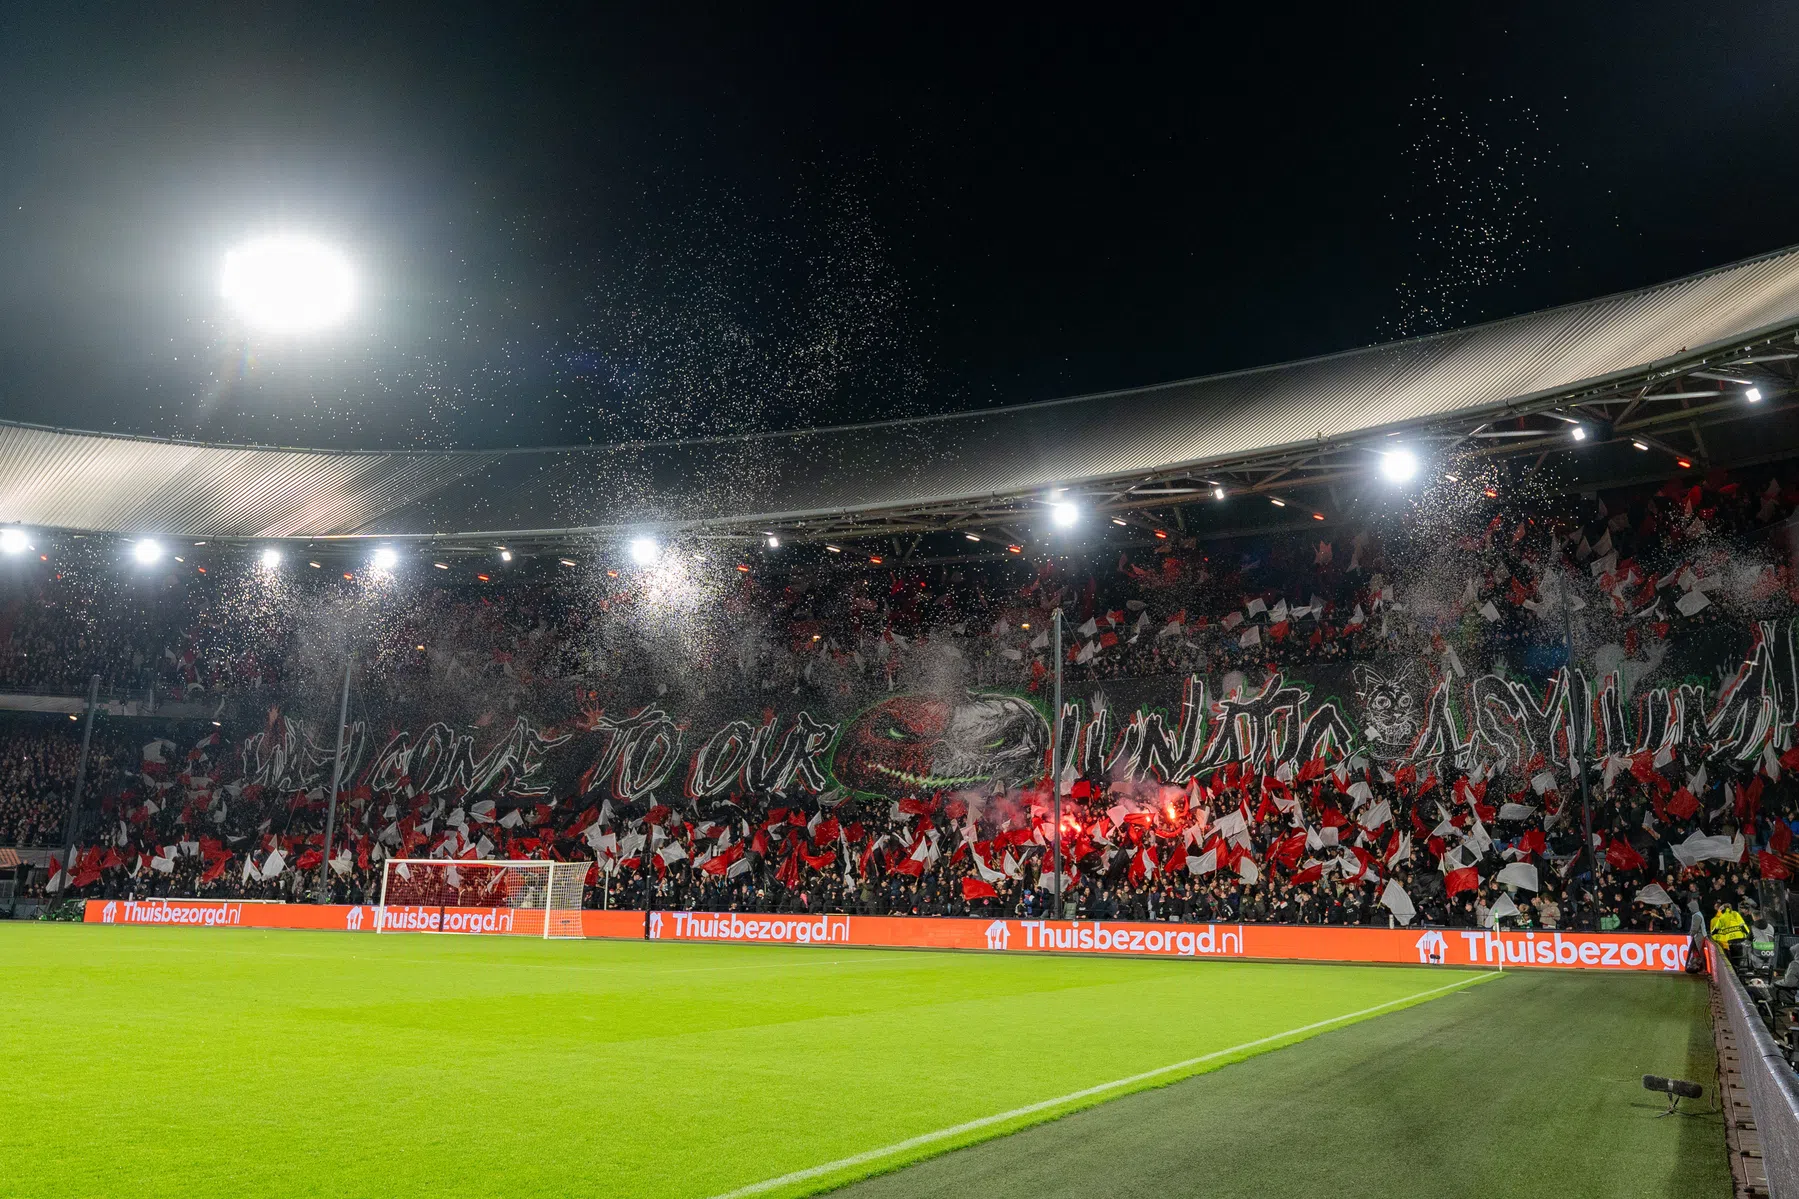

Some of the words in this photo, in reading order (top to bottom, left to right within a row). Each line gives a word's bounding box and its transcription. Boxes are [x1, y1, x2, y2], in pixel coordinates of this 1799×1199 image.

[588, 702, 682, 801] TO
[691, 711, 840, 797] OUR
[123, 896, 242, 927] Thuisbezorgd.nl
[371, 904, 515, 933] Thuisbezorgd.nl
[672, 911, 851, 943] Thuisbezorgd.nl
[1020, 920, 1244, 956] Thuisbezorgd.nl
